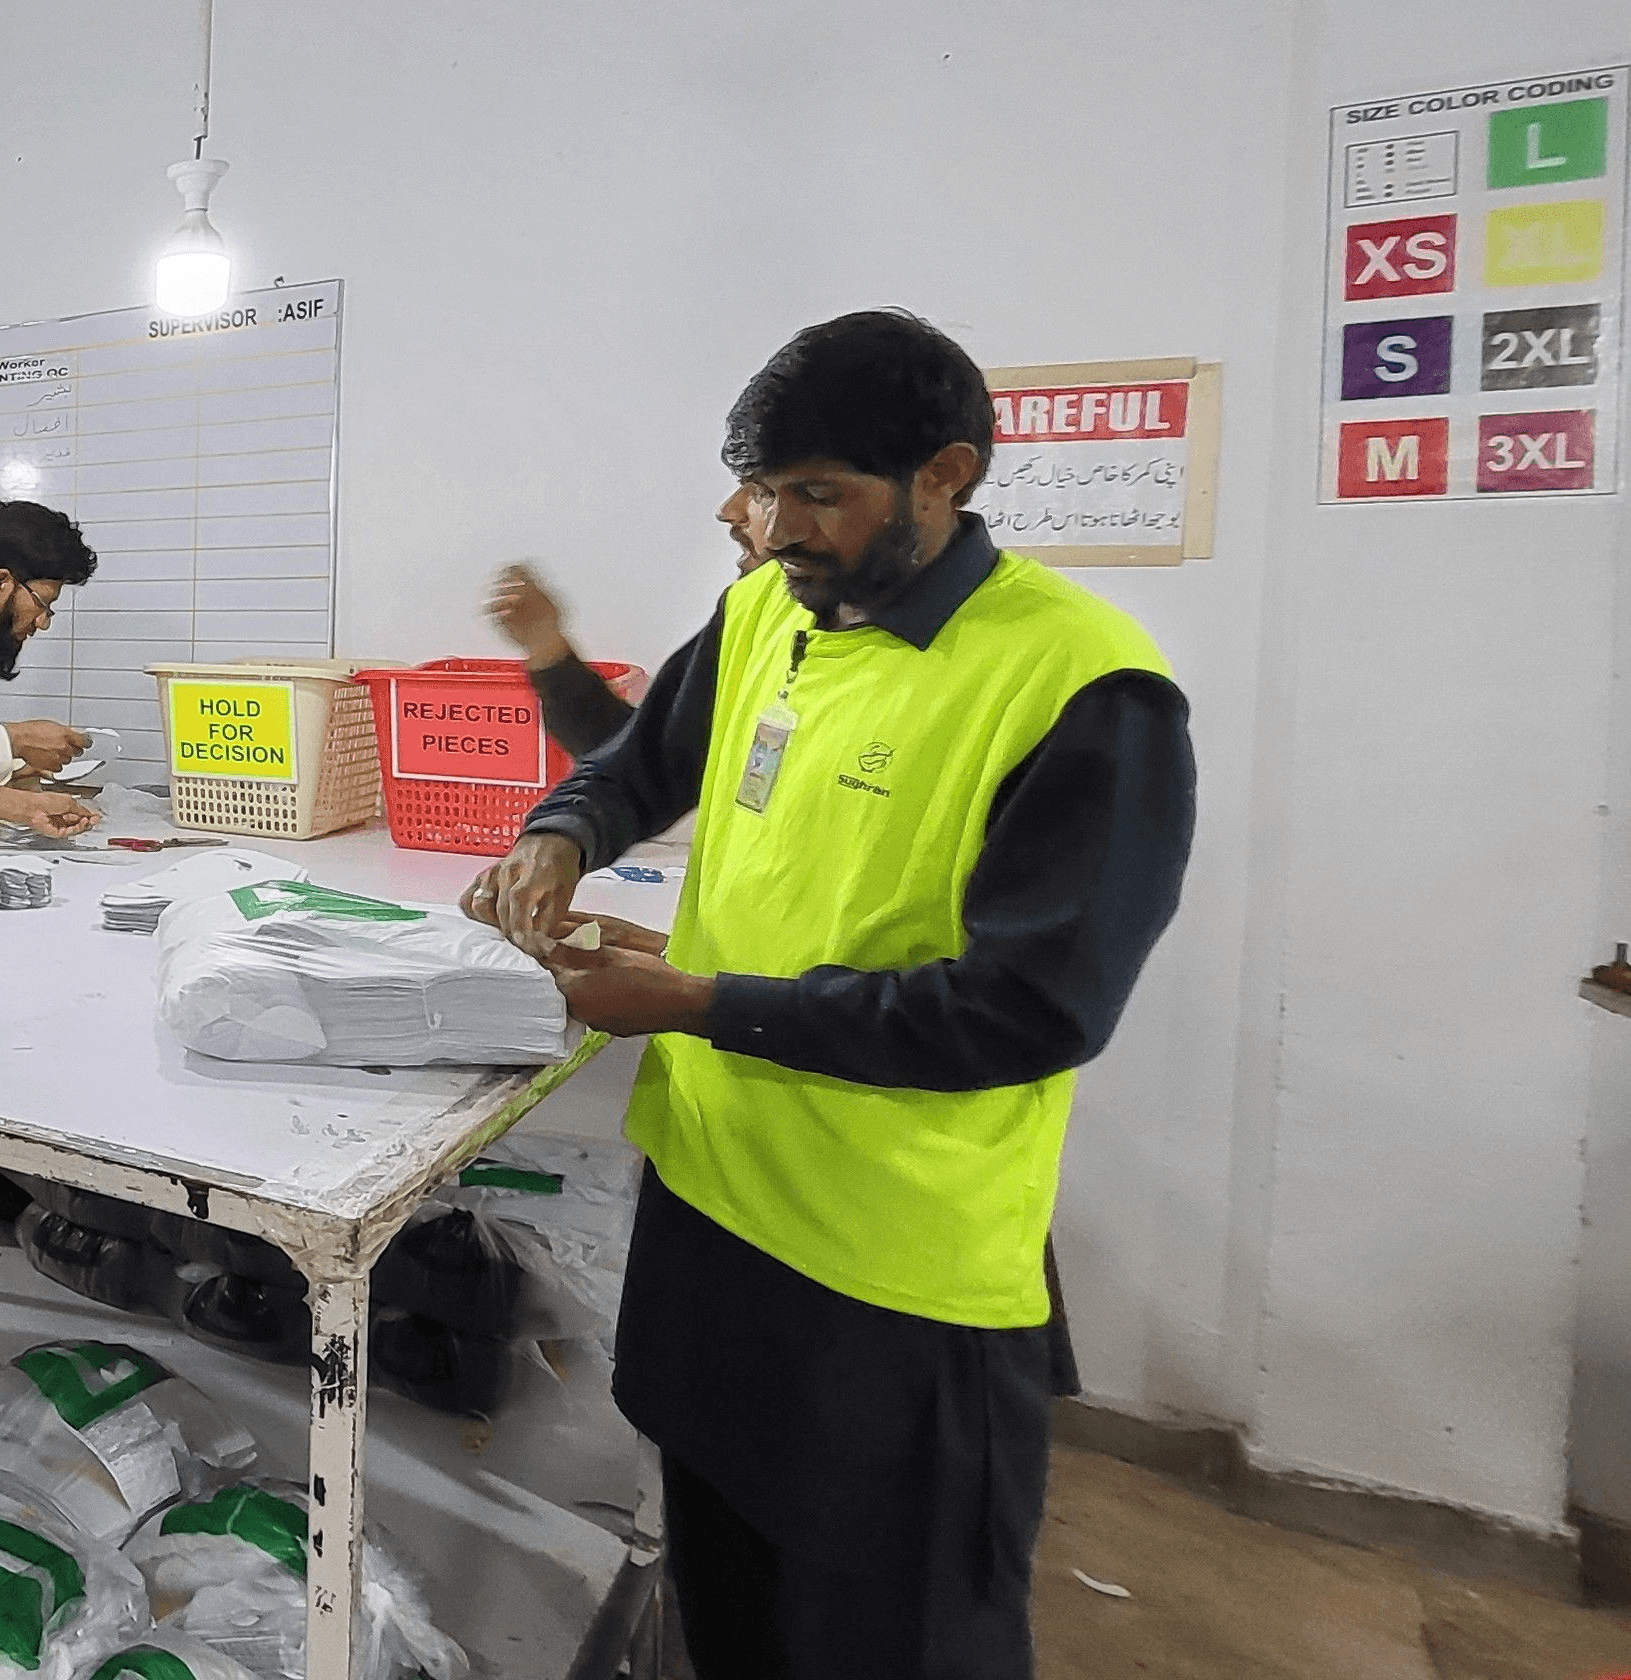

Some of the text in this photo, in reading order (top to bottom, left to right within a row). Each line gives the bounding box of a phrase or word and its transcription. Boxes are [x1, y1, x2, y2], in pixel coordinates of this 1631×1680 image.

[1345, 73, 1615, 125] SIZE COLOR CODING
[1526, 122, 1568, 169] L
[1353, 230, 1448, 285] XS
[148, 308, 258, 338] SUPERVISOR
[1373, 334, 1418, 383] S
[1488, 327, 1592, 370] 2XL
[992, 391, 1171, 435] AREFUL
[1365, 435, 1420, 483] M
[1486, 431, 1586, 472] 3XL
[199, 698, 261, 718] HOLD
[403, 701, 532, 725] REJECTED
[180, 741, 285, 764] DECISION
[209, 723, 255, 742] FOR
[422, 734, 510, 756] PIECES
